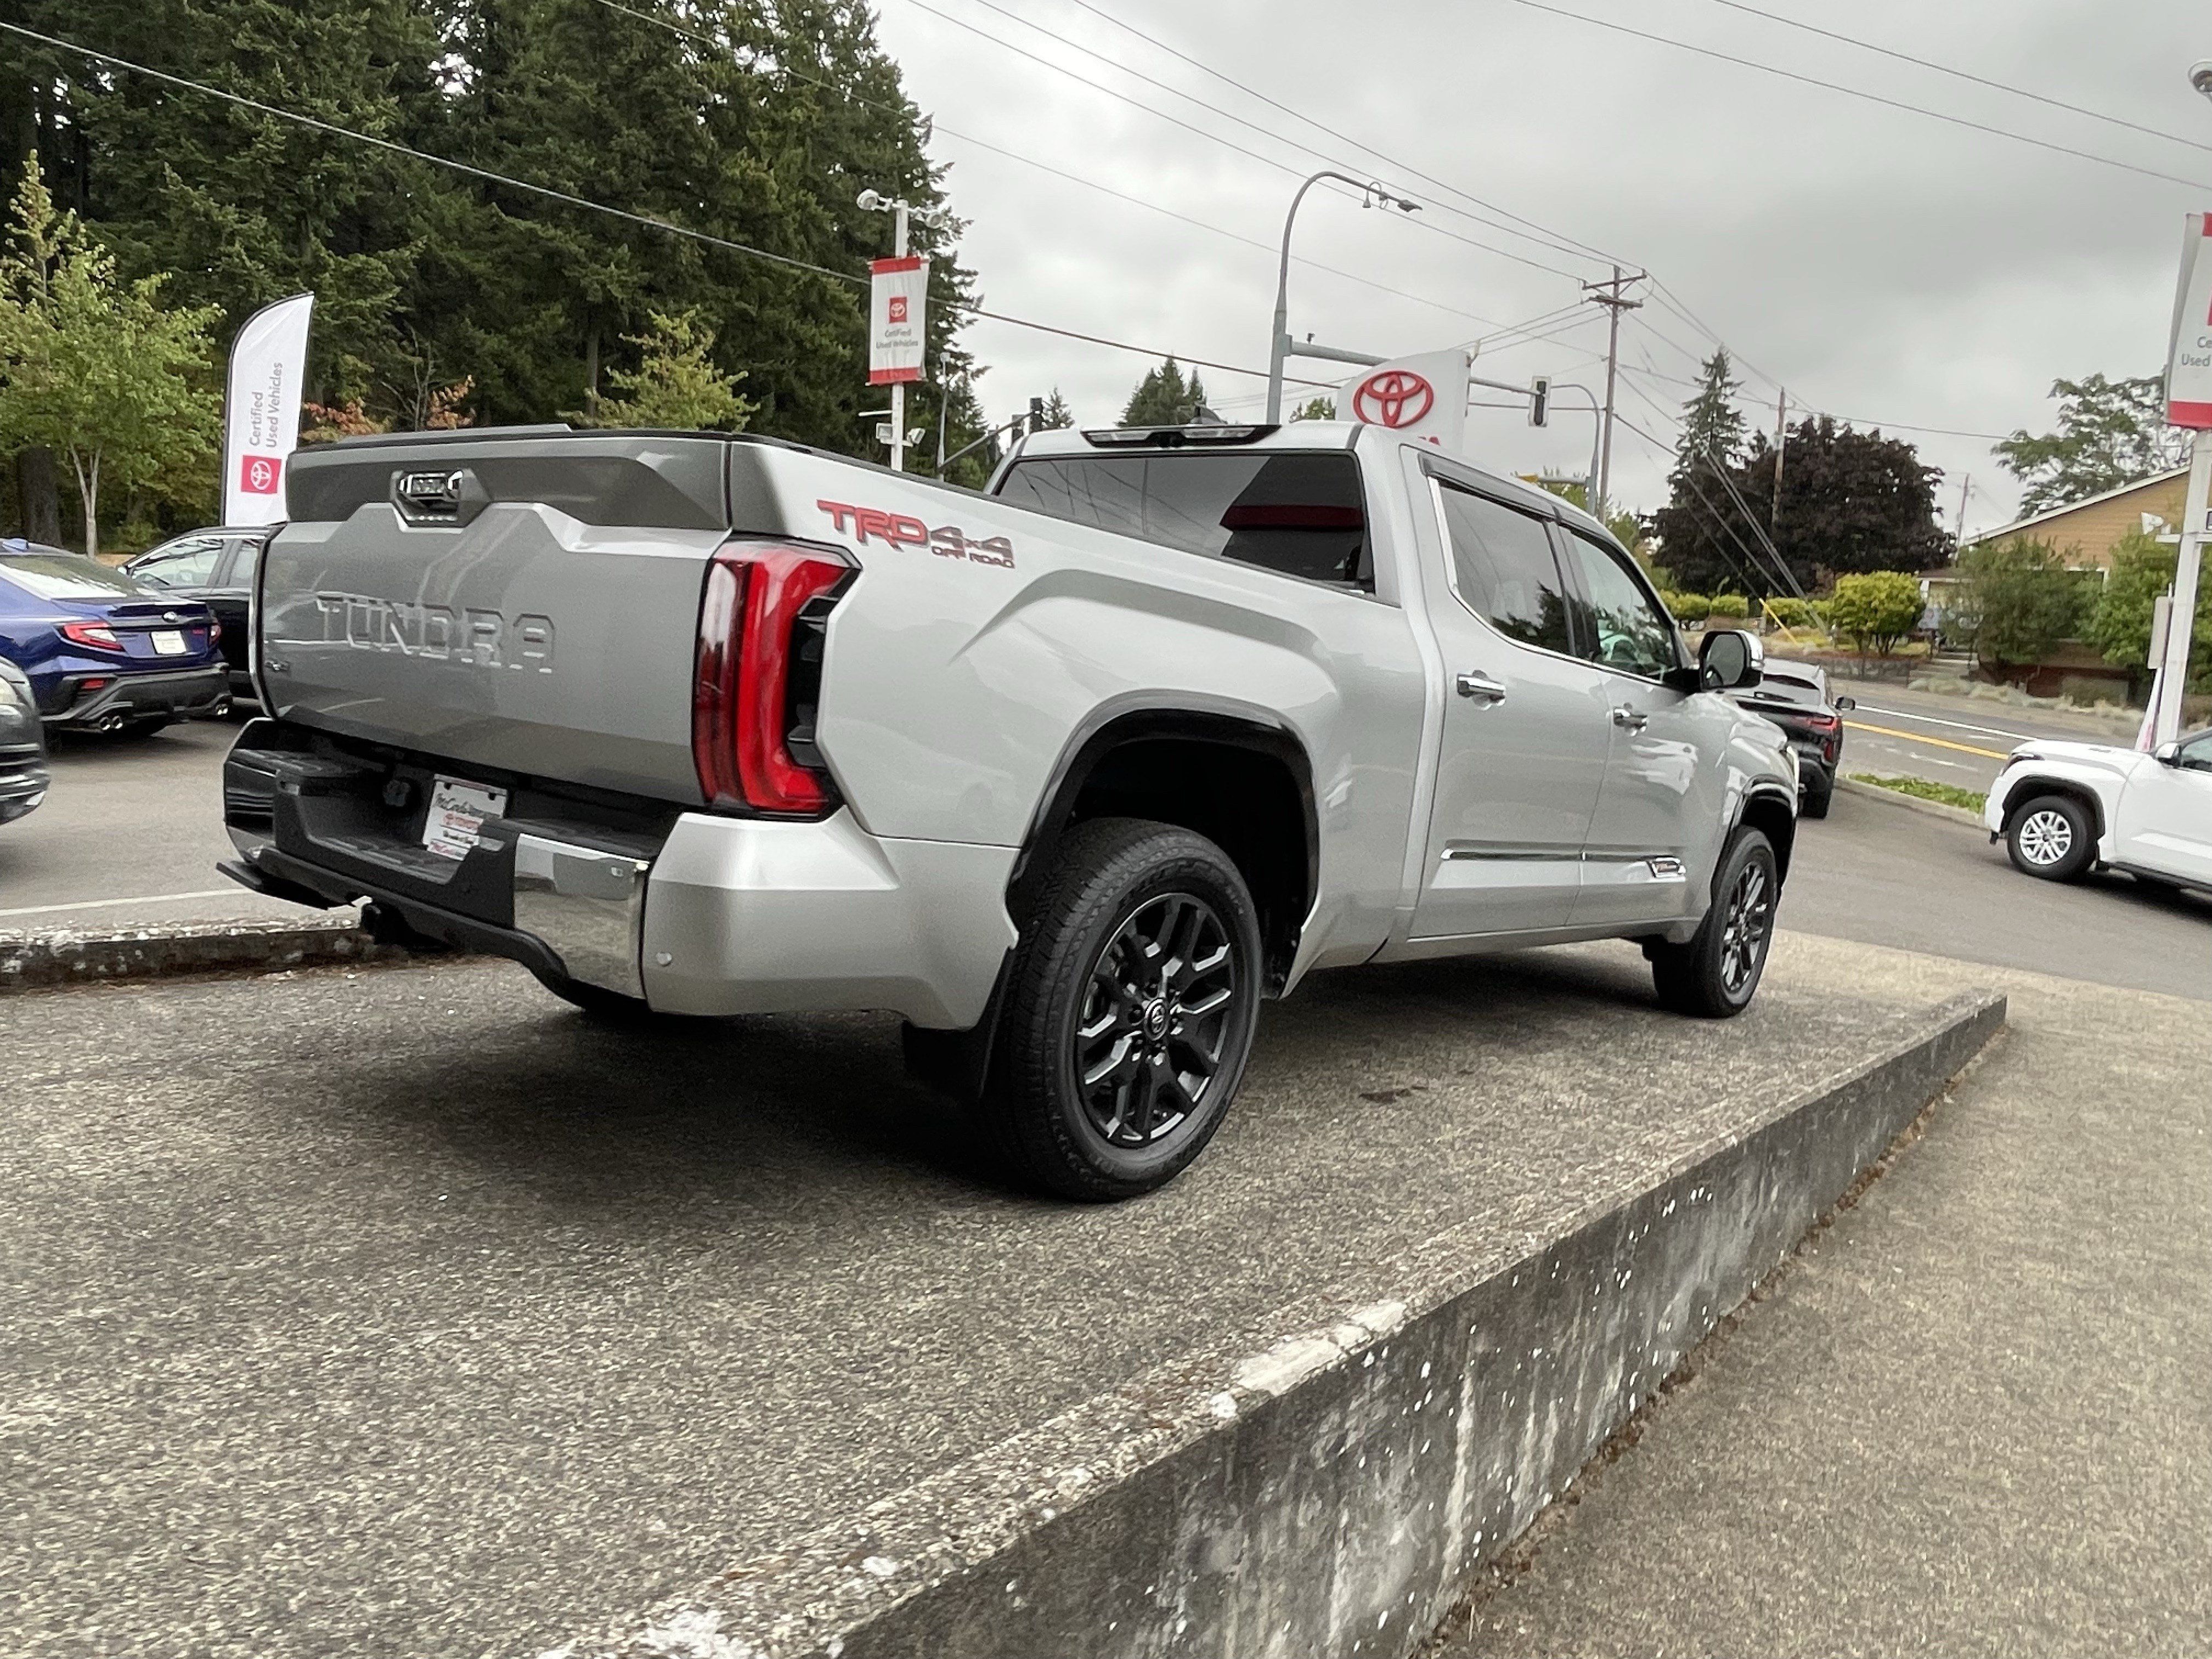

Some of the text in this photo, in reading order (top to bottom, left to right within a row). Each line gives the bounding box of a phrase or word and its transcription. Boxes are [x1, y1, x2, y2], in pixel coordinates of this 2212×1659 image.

[2181, 353, 2210, 366] Used
[250, 392, 263, 446] Certified
[266, 362, 283, 448] Used Vehicles
[817, 499, 929, 551] TRD
[317, 591, 555, 673] TUNDRA
